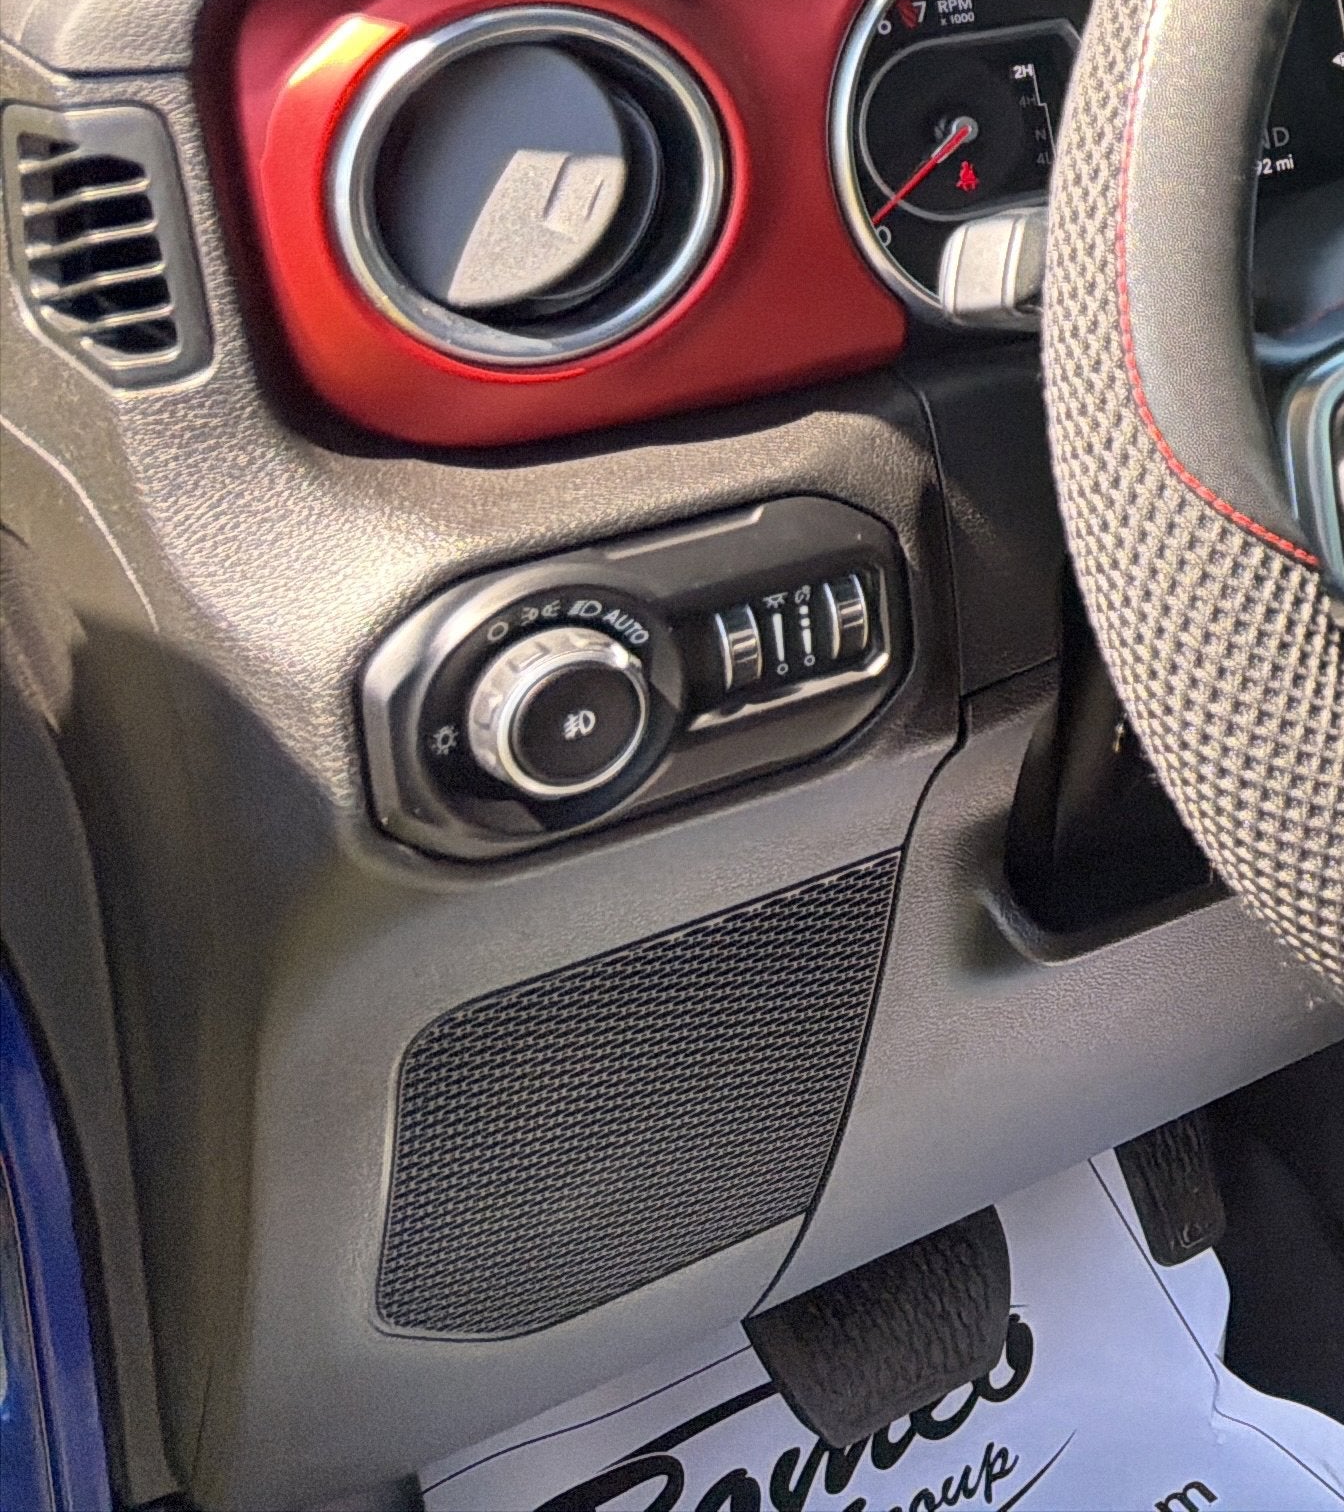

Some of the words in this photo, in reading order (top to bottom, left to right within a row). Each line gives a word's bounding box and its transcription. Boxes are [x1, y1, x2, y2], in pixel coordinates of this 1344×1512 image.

[912, 0, 927, 23] 7
[951, 11, 975, 25] 1000
[1013, 63, 1034, 80] 2H
[1275, 153, 1295, 172] mi
[602, 608, 649, 645] AUTO
